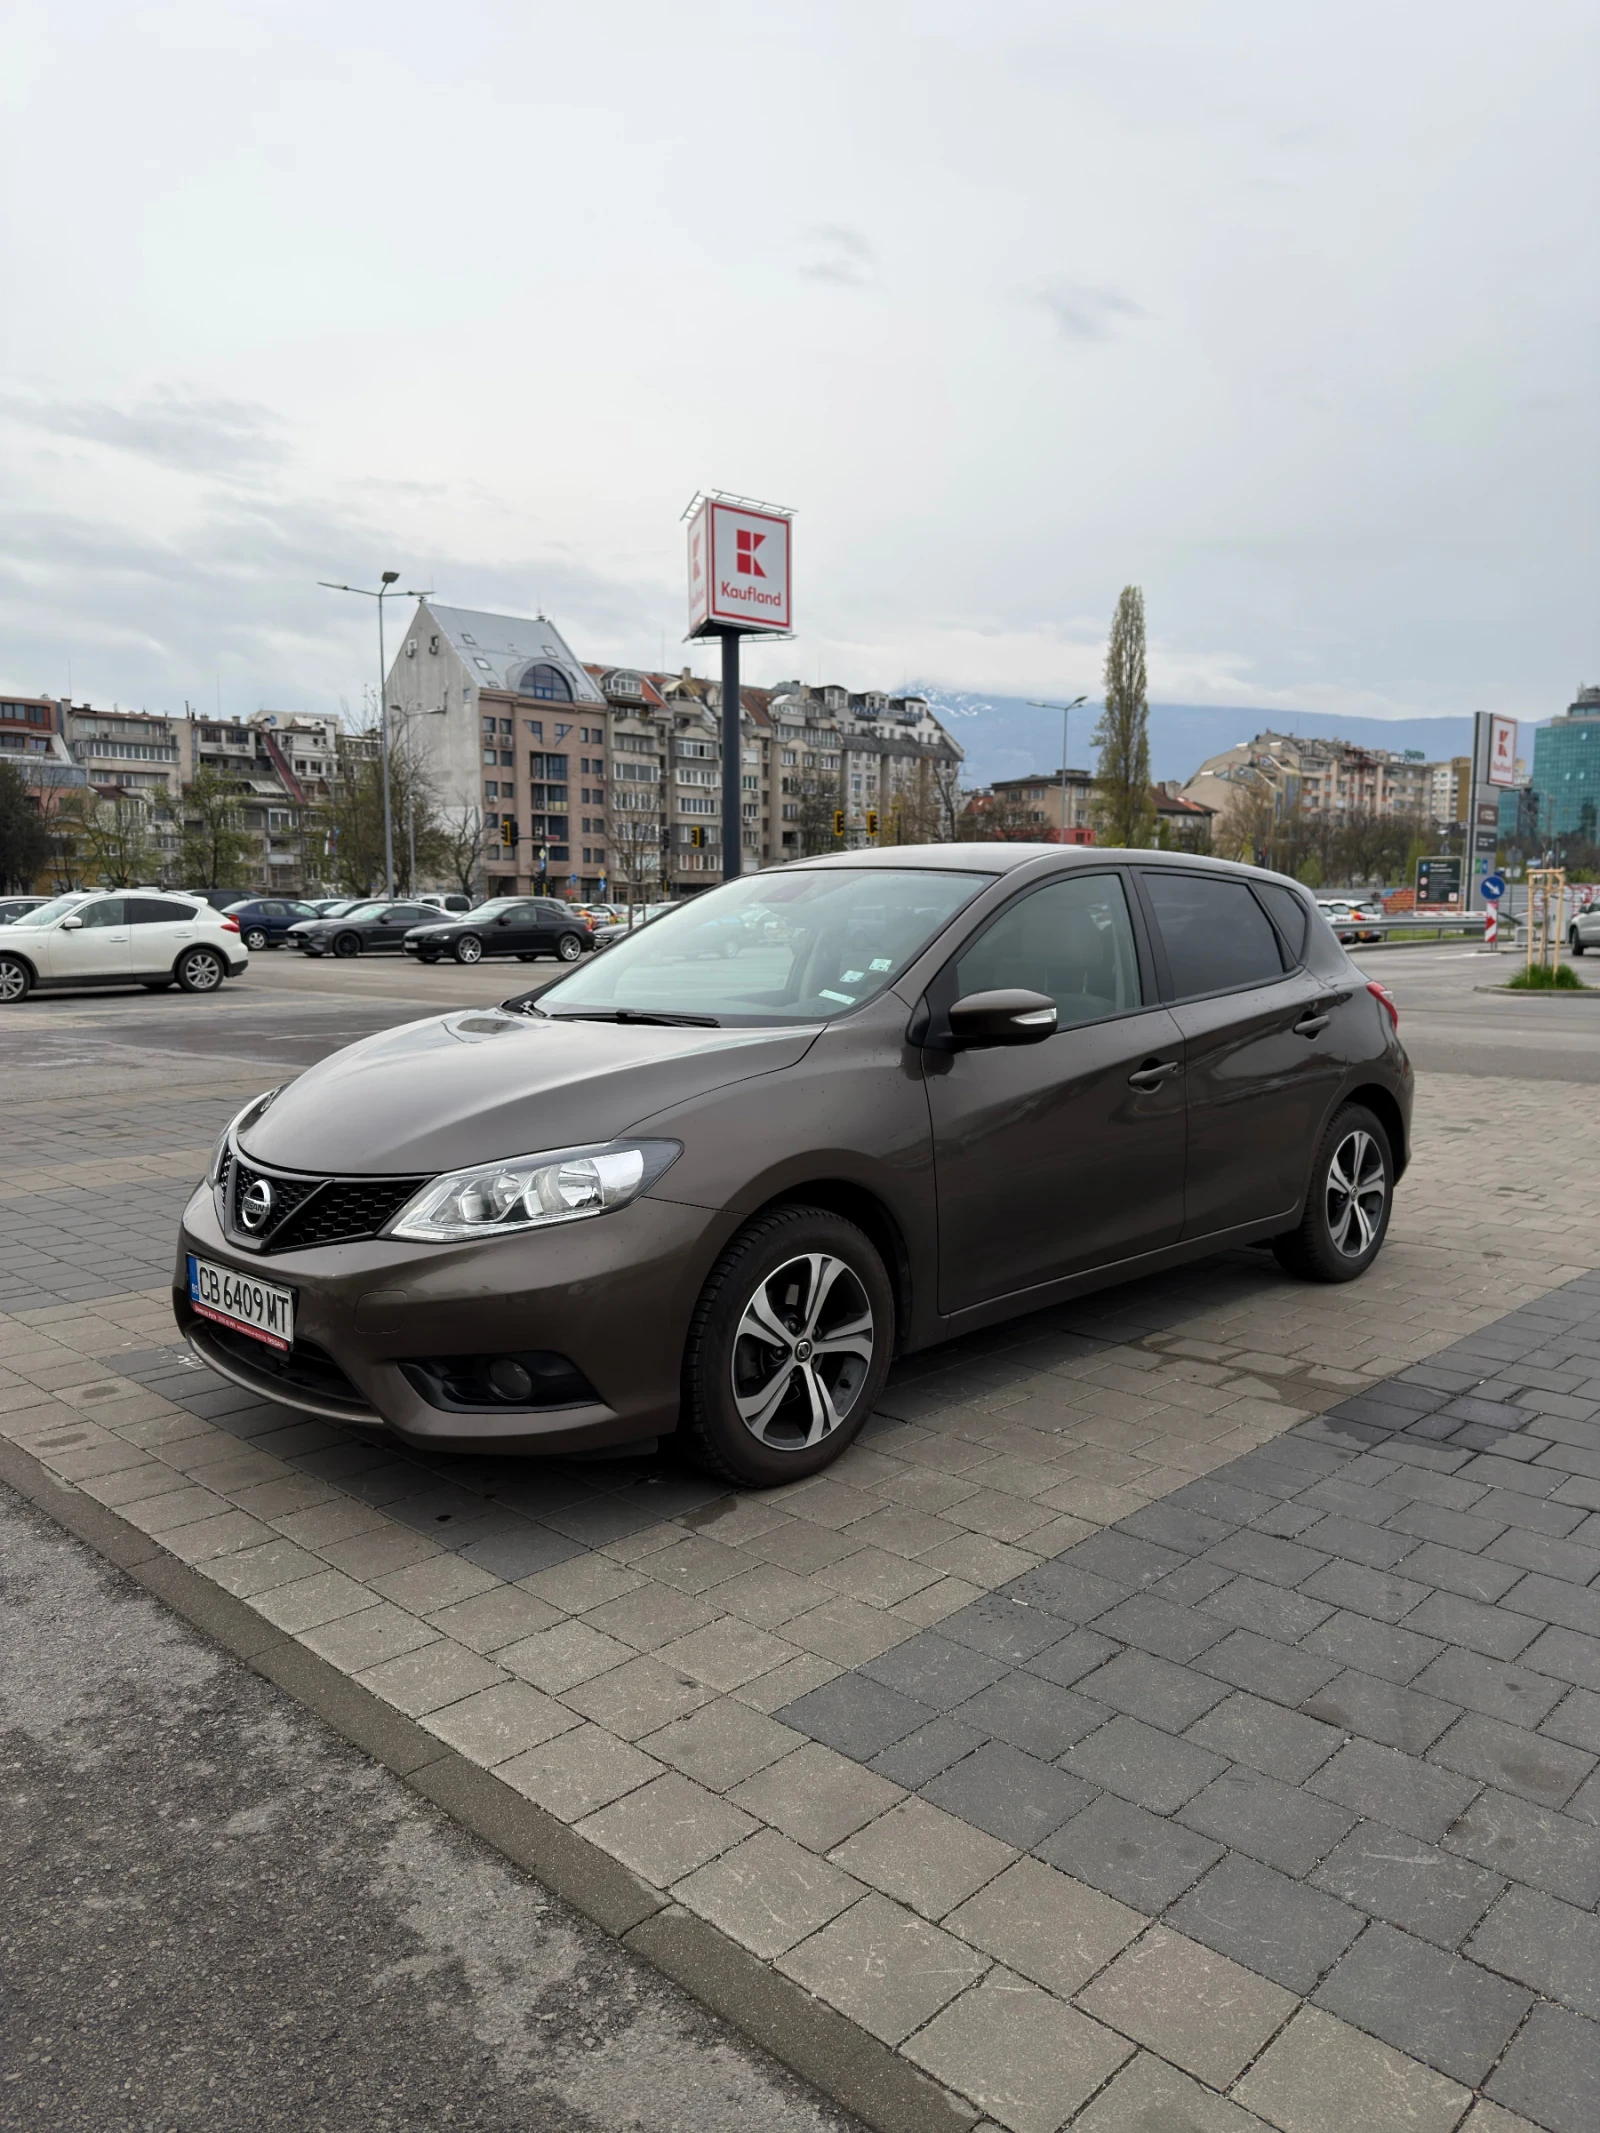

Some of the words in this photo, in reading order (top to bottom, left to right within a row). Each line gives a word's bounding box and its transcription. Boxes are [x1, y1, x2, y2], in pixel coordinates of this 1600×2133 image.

[737, 529, 767, 579] K
[721, 581, 781, 607] Kaufland
[223, 1275, 264, 1322] 6409
[267, 1290, 289, 1333] MT
